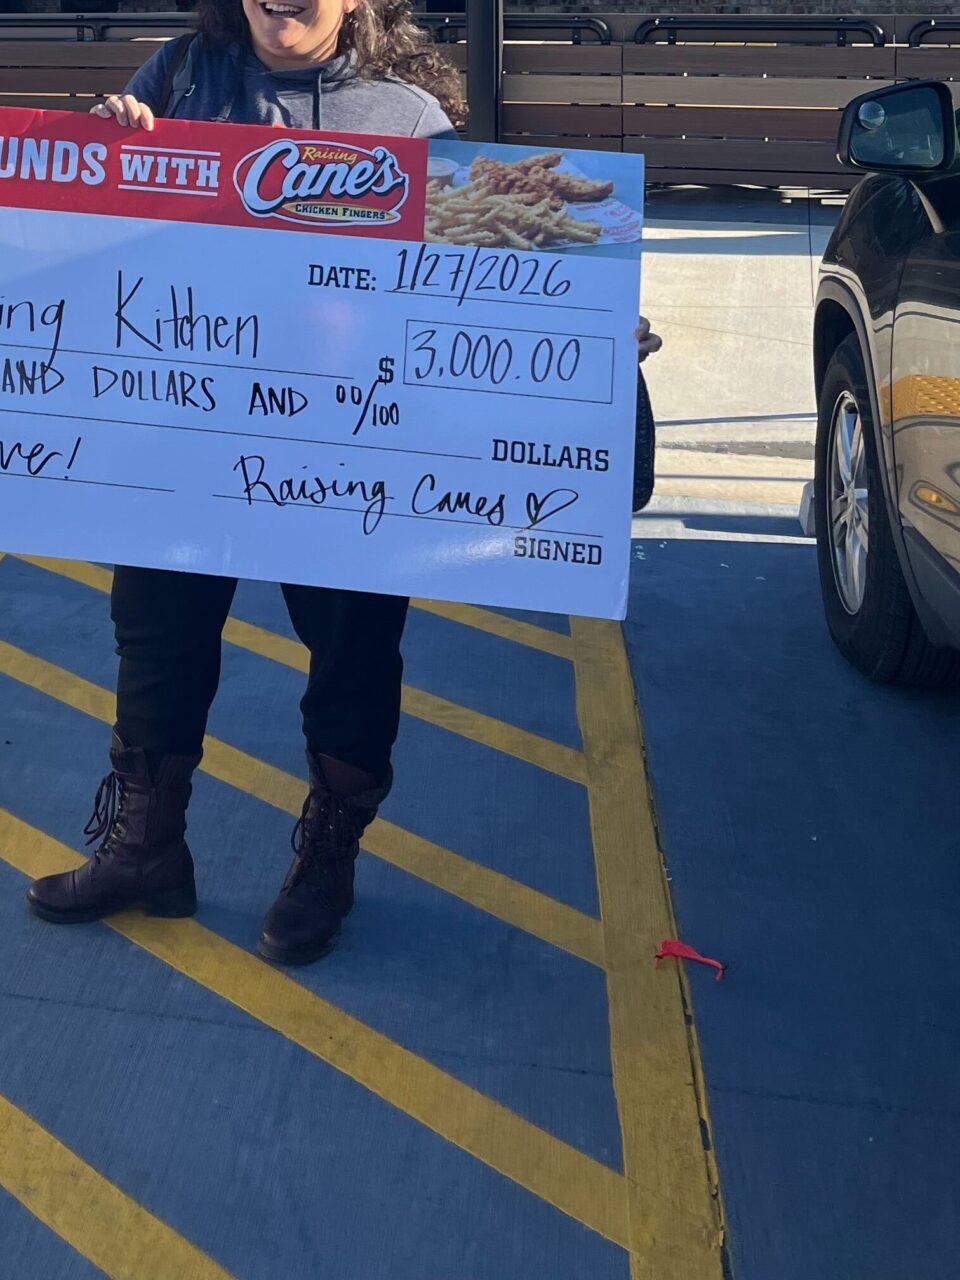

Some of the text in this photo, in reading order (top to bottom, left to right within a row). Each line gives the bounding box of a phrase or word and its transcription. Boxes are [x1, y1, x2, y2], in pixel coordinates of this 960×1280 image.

[120, 151, 220, 187] WITH
[302, 146, 359, 164] Raising
[241, 140, 410, 208] Cane's
[295, 203, 386, 220] CHICKEN FINGERS
[308, 264, 377, 291] DATE:
[393, 243, 572, 307] 1/27/2026
[115, 269, 259, 358] Kitchen
[378, 356, 395, 385] $
[92, 365, 217, 413] DOLLARS
[248, 383, 308, 417] AND
[491, 438, 610, 472] DOLLARS
[234, 454, 505, 535] Raising Canes
[513, 536, 603, 567] SIGNED
